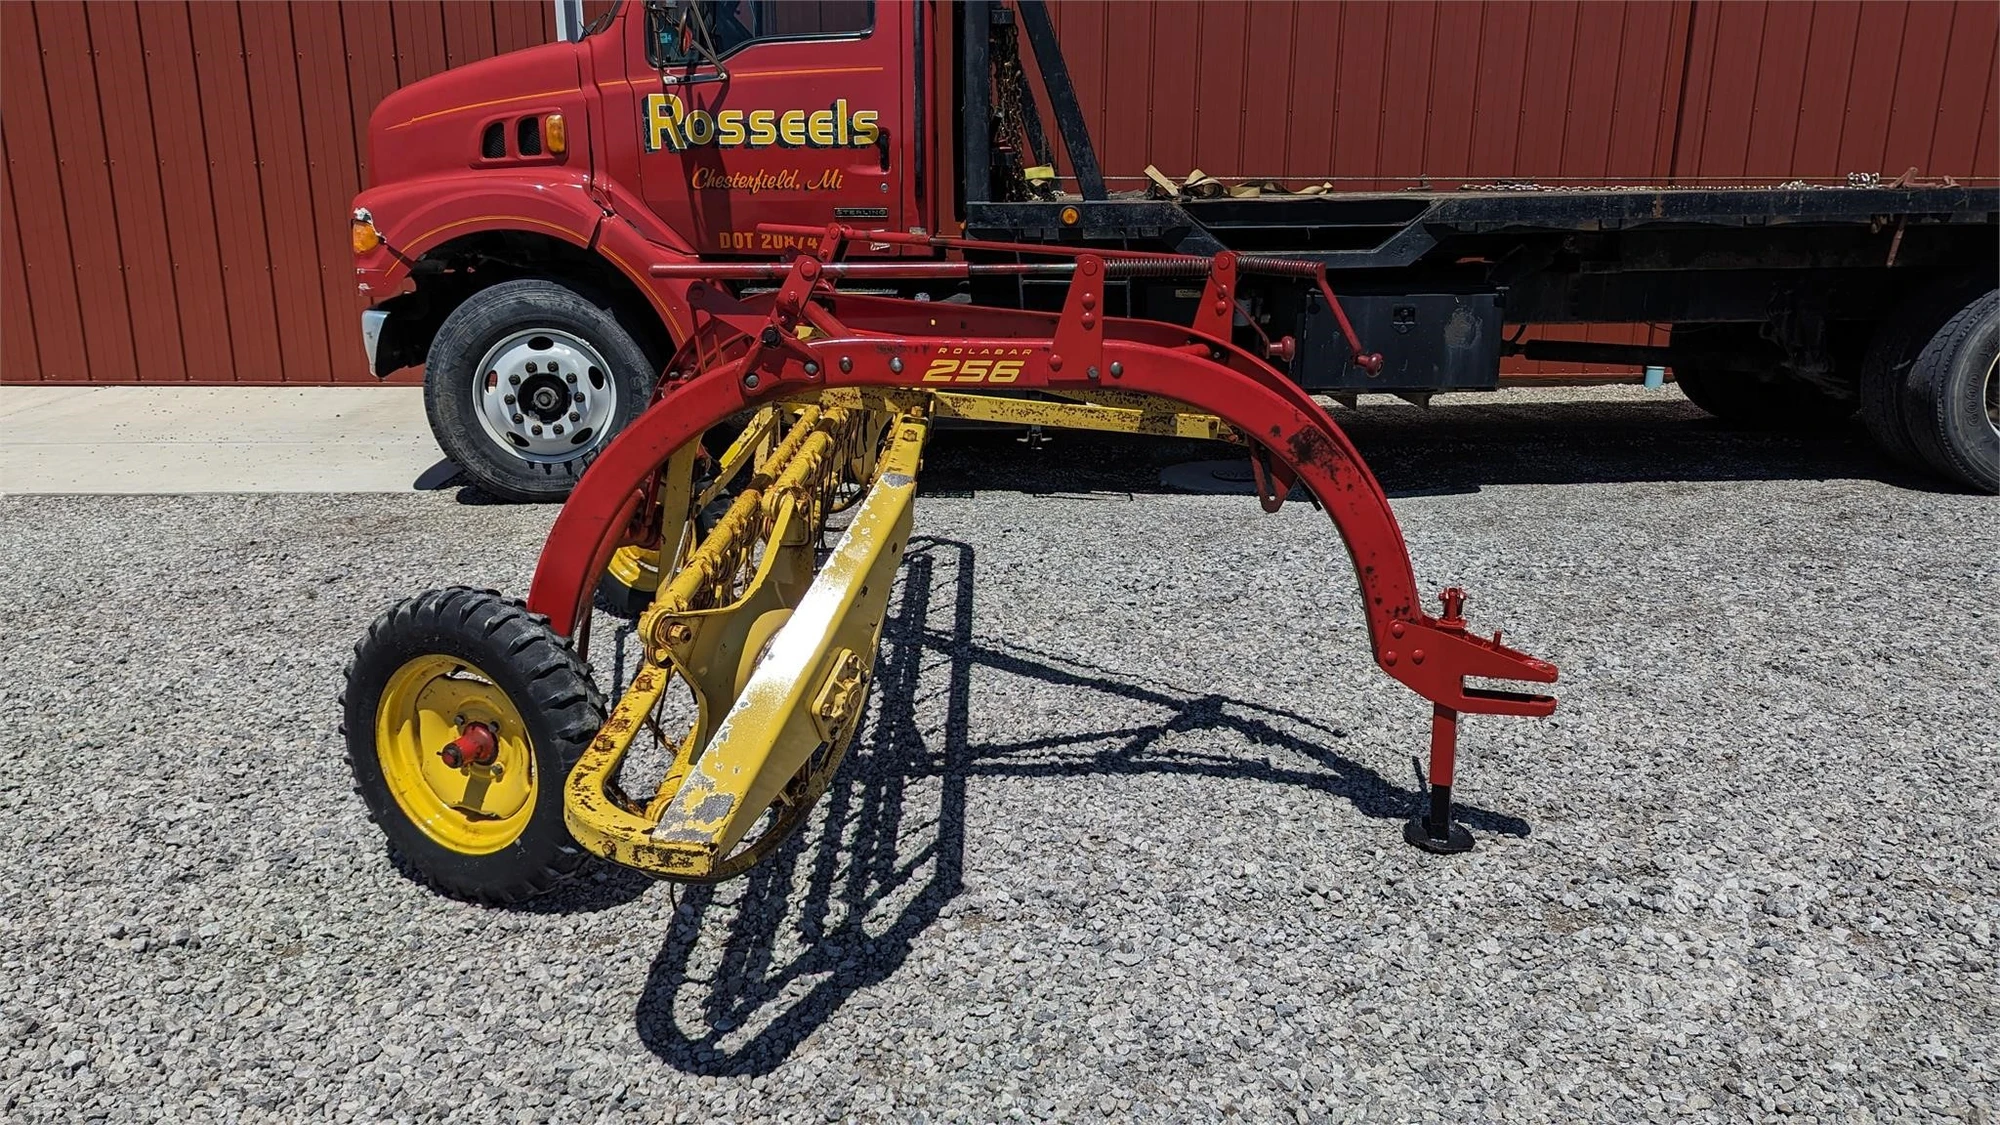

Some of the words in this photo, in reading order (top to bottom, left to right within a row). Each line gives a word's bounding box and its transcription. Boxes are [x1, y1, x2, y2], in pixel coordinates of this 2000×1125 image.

[645, 93, 880, 150] Rosseels
[692, 166, 800, 194] Chesterfield,
[807, 168, 844, 190] Mi
[719, 232, 754, 249] DOT
[937, 347, 1032, 355] ROLABAR
[922, 359, 1024, 382] 256
